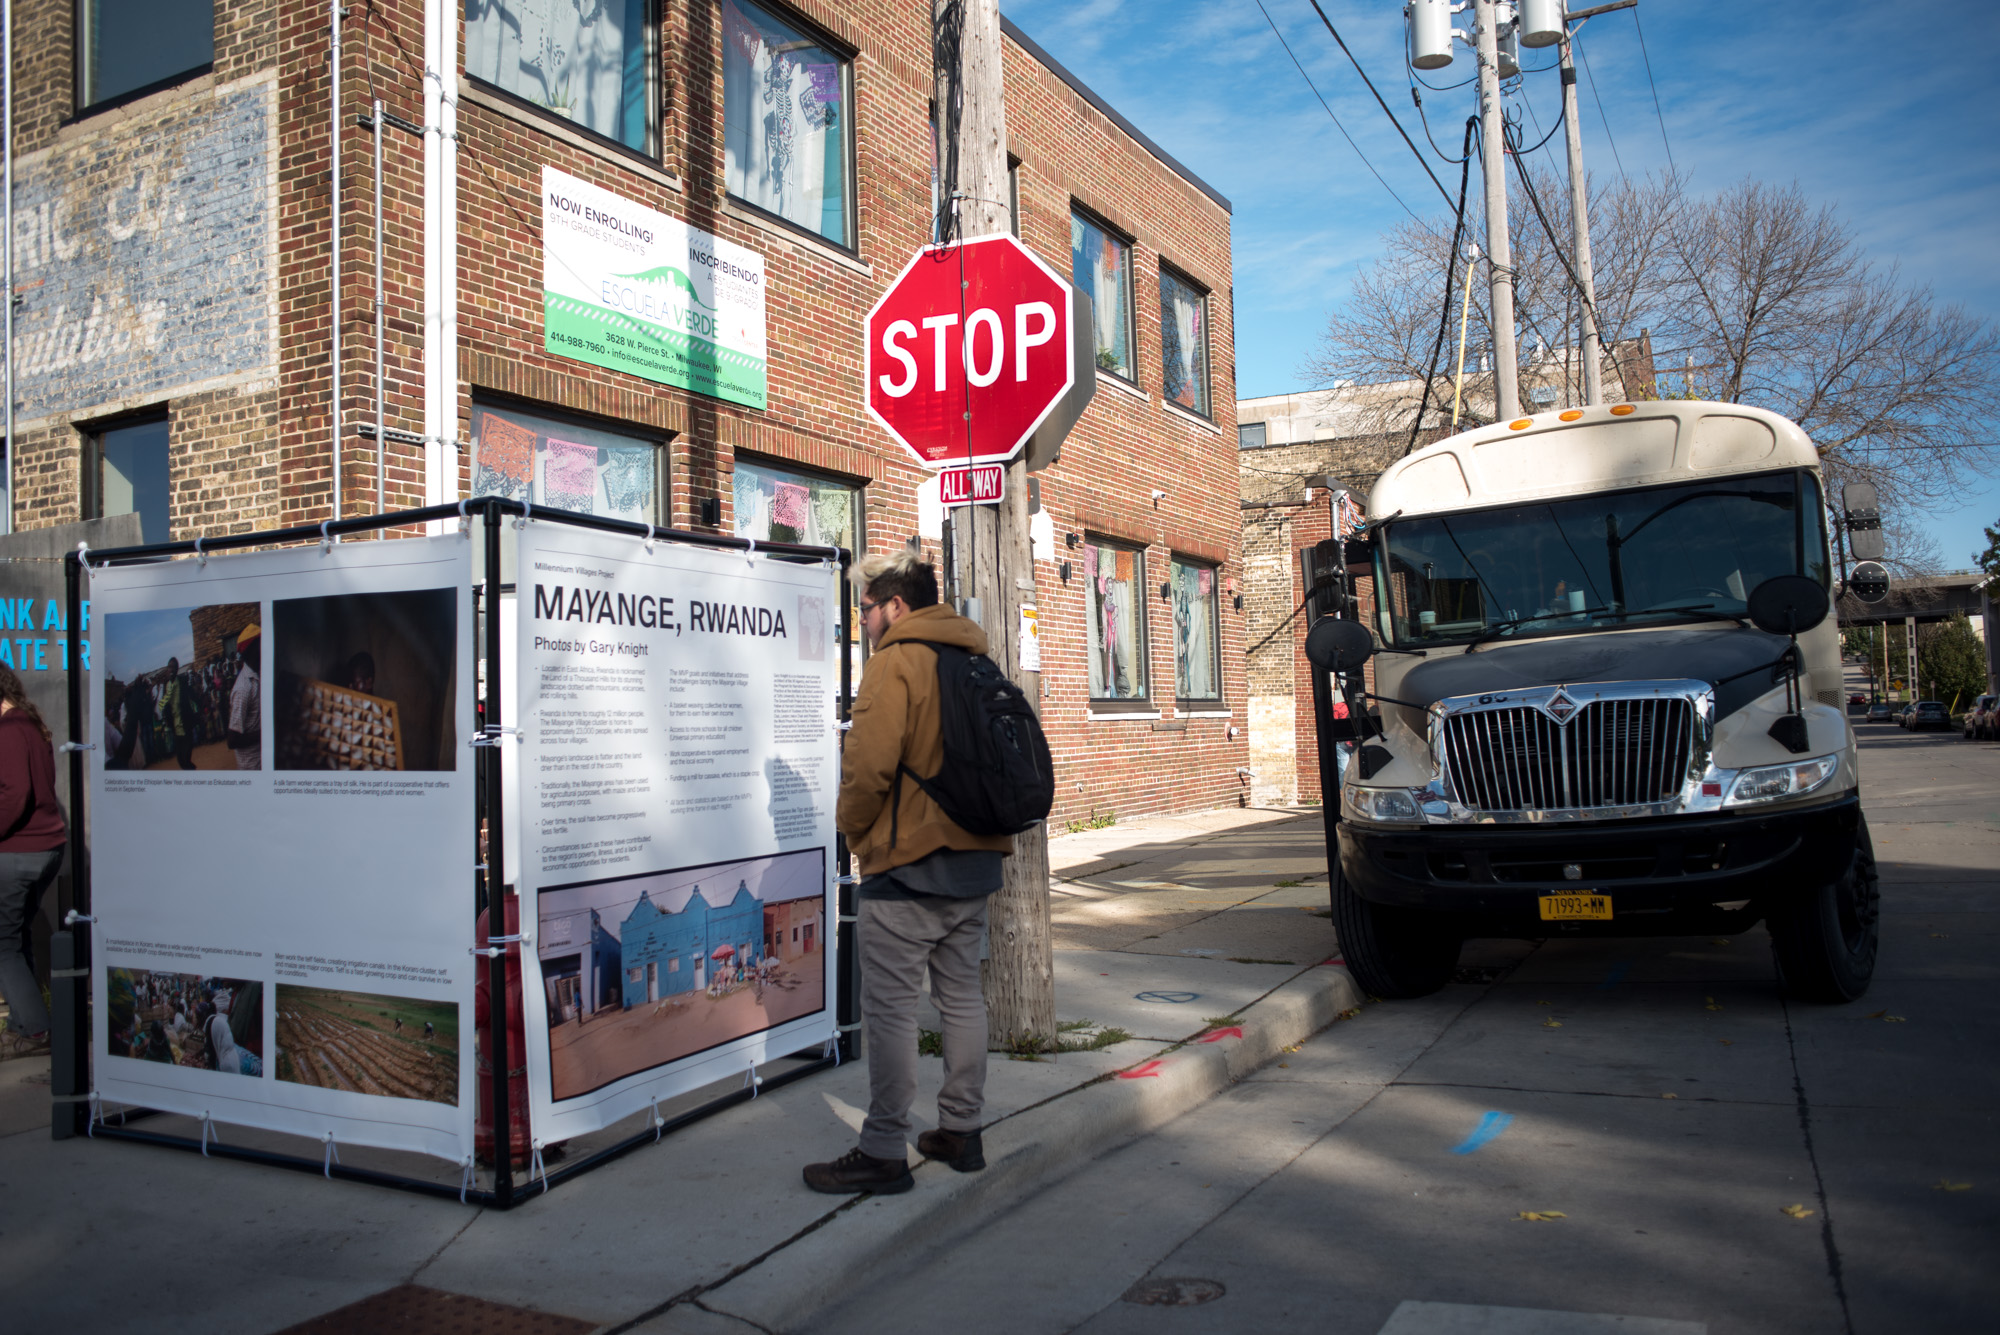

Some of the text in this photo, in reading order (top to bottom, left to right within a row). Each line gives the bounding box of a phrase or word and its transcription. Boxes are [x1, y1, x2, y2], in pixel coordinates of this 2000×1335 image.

[550, 193, 654, 245] NOW ENROLLING!
[550, 213, 646, 256] 9TH GRADE STUDENTS
[690, 248, 758, 285] INSCRIBIENDO
[707, 272, 758, 299] A ESTUDIANTES
[715, 287, 724, 298] DE
[602, 280, 719, 339] ESCUELA VERDE
[550, 332, 762, 401] 414-988-7960 info@escuelaverde.org www.escuelaverde.org
[605, 332, 722, 374] 3628 W. Pierce St. Milwaukee, WI
[879, 301, 1057, 398] STOP
[942, 468, 999, 500] ALL WAY
[534, 562, 615, 579] Millennium Villages Project
[0, 598, 34, 630] NK
[534, 584, 787, 638] MAYANGE, RWANDA
[0, 638, 48, 671] ATE
[534, 636, 648, 658] Photos by Gary Knight
